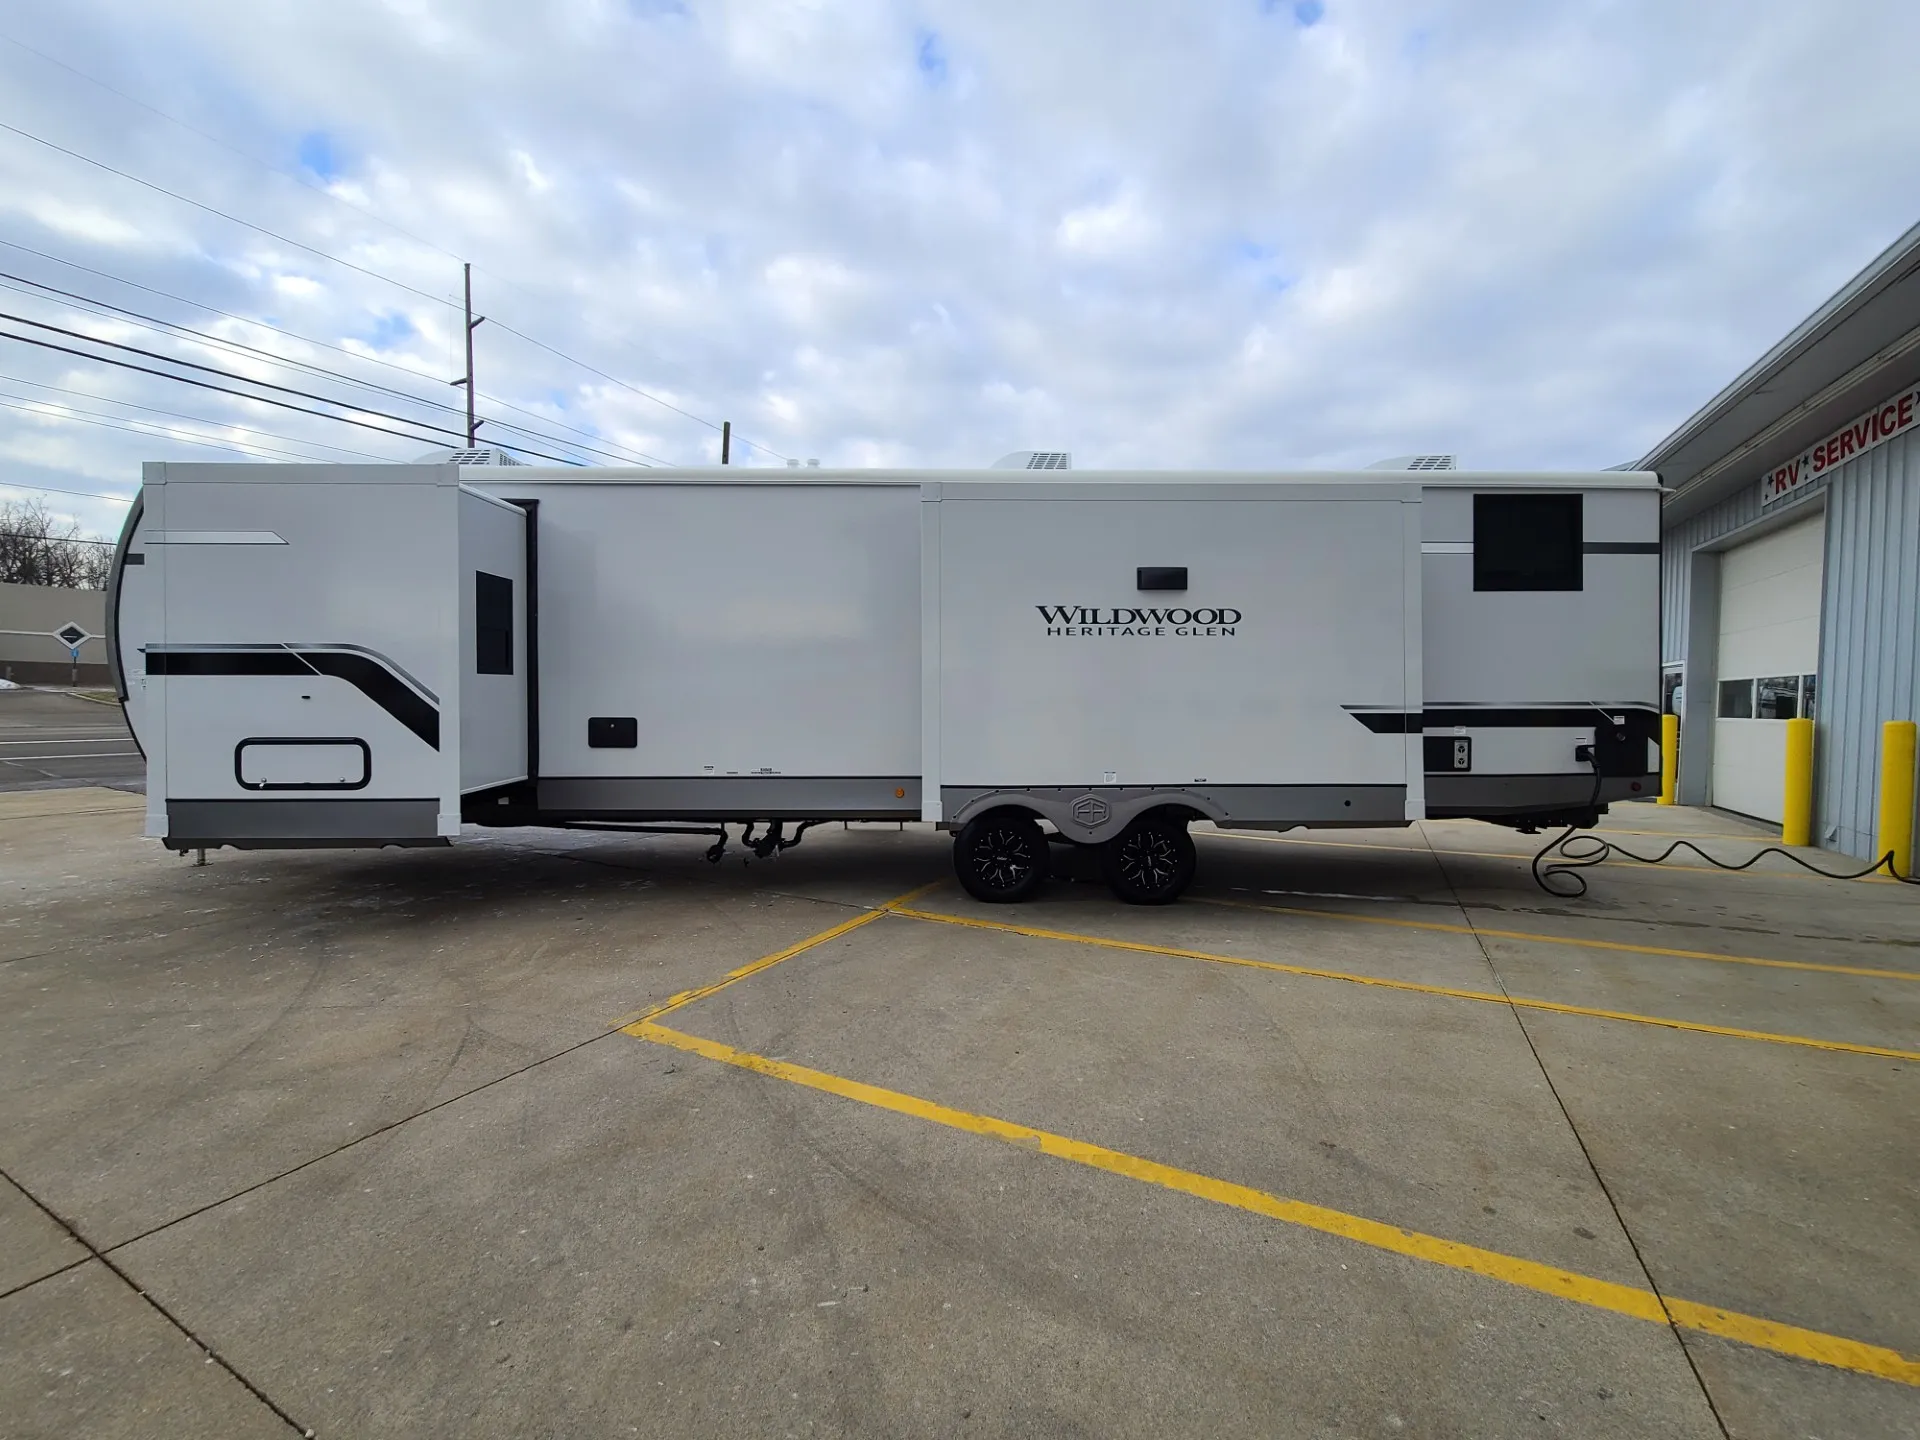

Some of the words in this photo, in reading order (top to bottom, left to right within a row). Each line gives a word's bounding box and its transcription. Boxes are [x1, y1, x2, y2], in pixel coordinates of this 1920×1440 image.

[1775, 459, 1801, 494] RV
[1812, 392, 1914, 473] SERVICE
[1035, 605, 1242, 625] WILDWOOD
[1047, 626, 1166, 636] HERITAGE
[1175, 626, 1236, 636] GLEN
